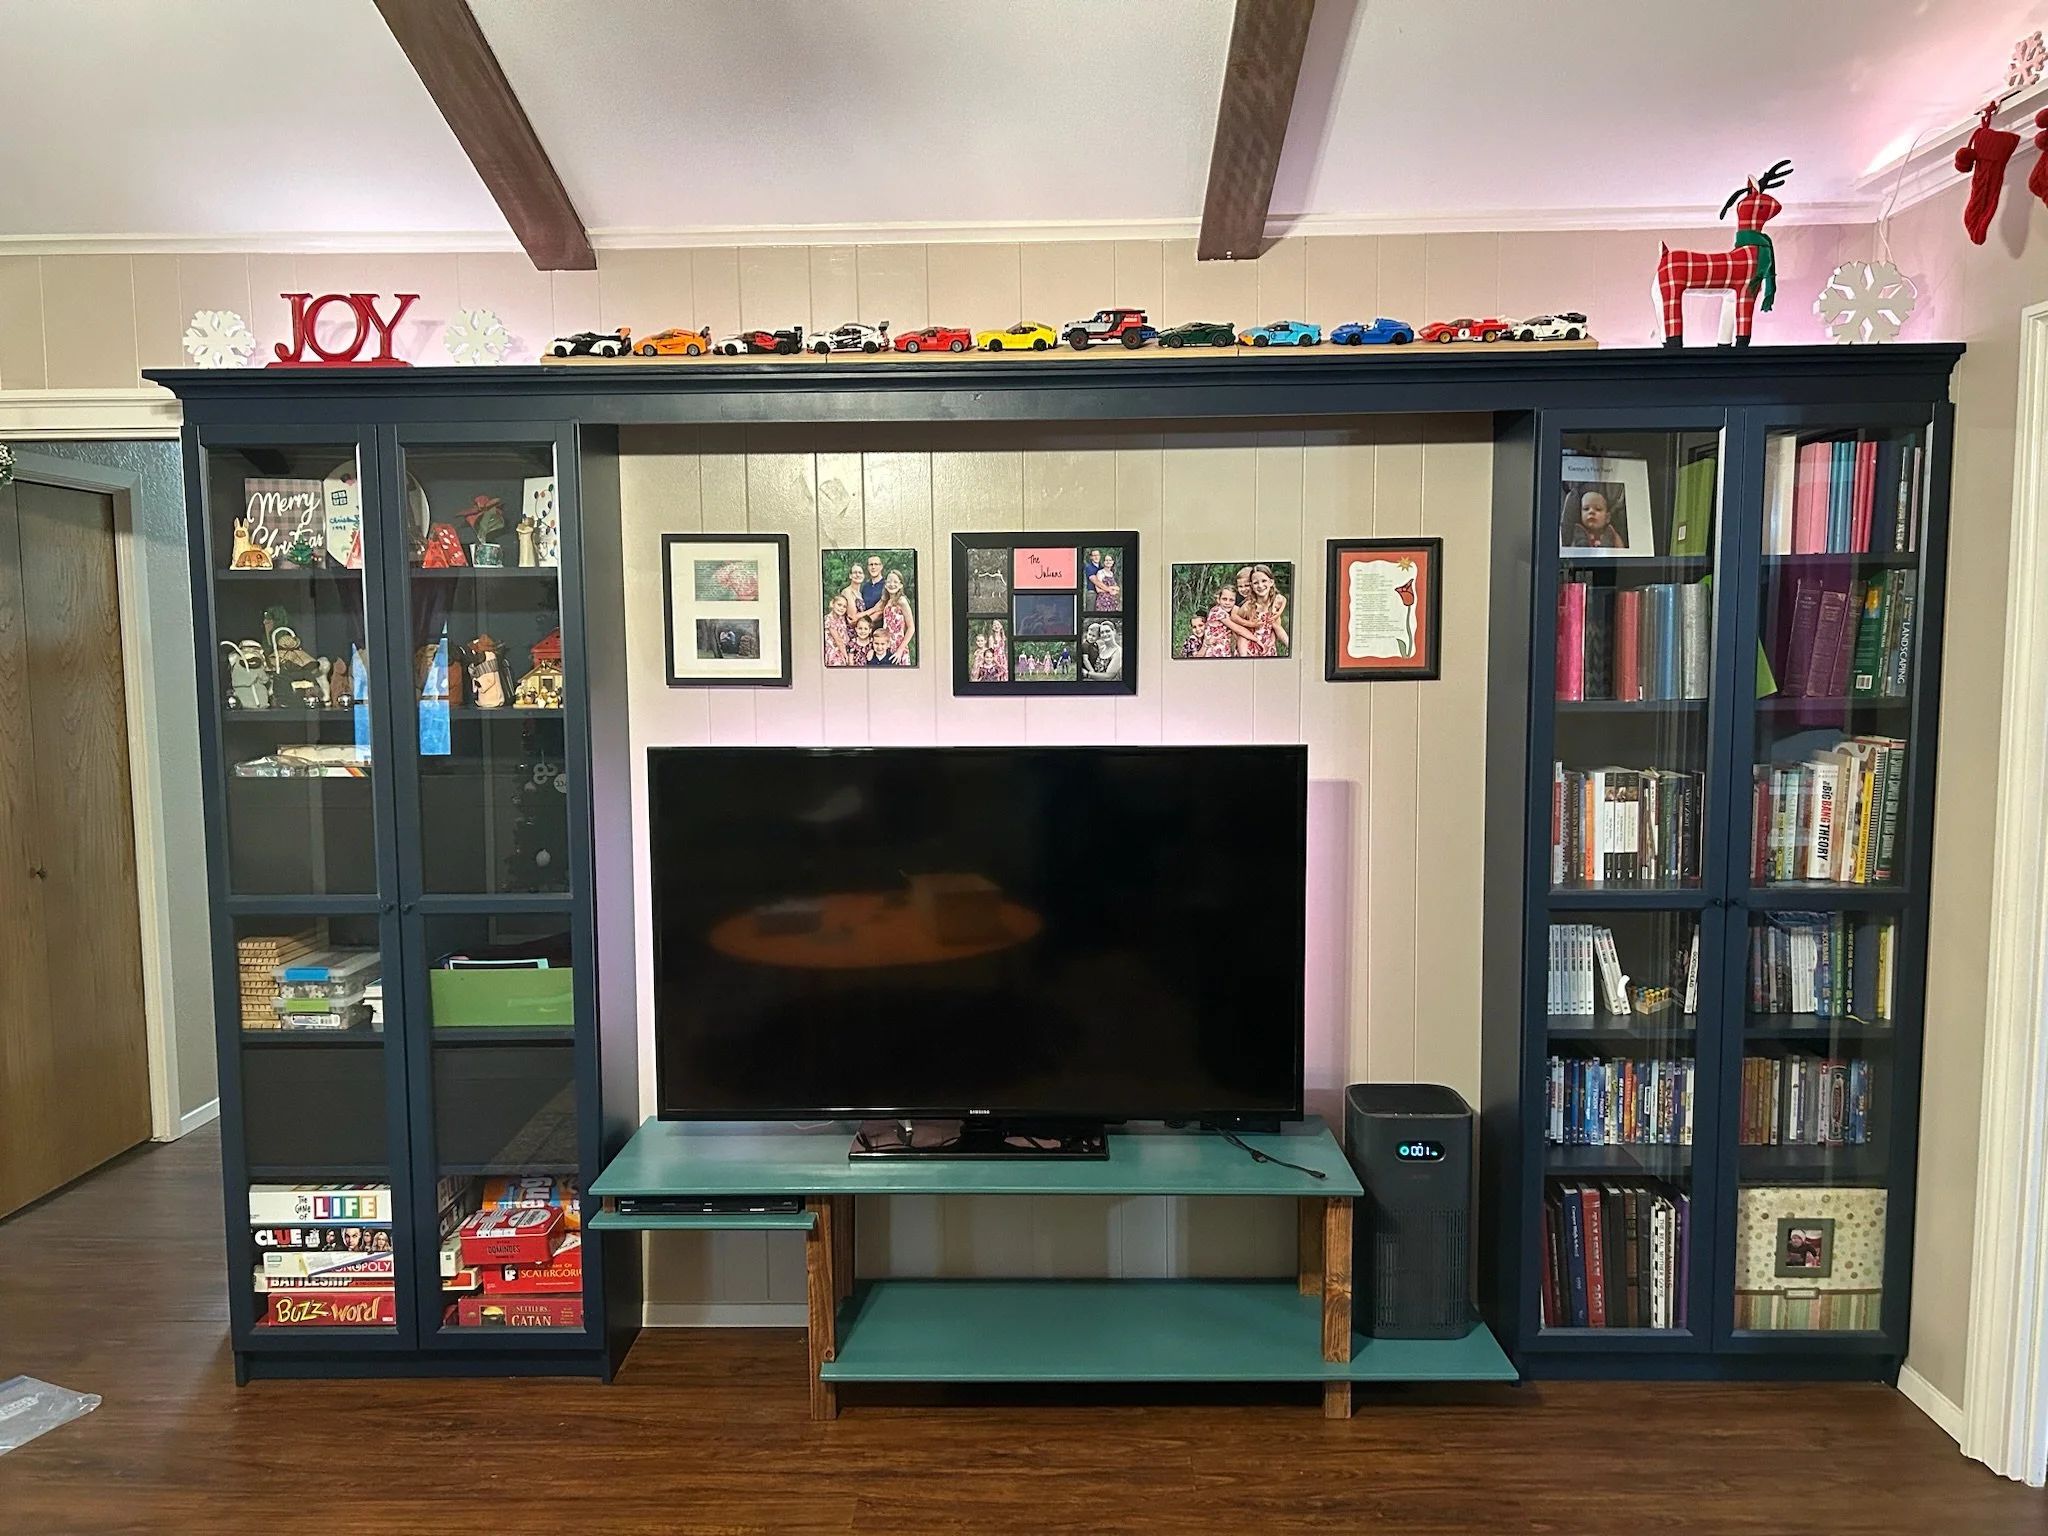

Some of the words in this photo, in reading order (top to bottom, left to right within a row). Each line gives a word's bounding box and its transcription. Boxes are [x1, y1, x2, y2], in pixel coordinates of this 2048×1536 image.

[274, 292, 421, 362] JOY
[247, 491, 321, 528] Merry
[1028, 554, 1041, 565] The
[1897, 622, 1911, 684] LANDSCAPING
[1821, 786, 1832, 800] BIG
[1820, 800, 1832, 823] BANG
[1817, 824, 1830, 861] THEORY
[314, 1196, 377, 1219] LIFE
[254, 1228, 303, 1247] CLUE
[332, 1260, 392, 1273] ONOPOLY
[269, 1276, 353, 1288] BATTLESHIP
[511, 1314, 552, 1326] CATAN
